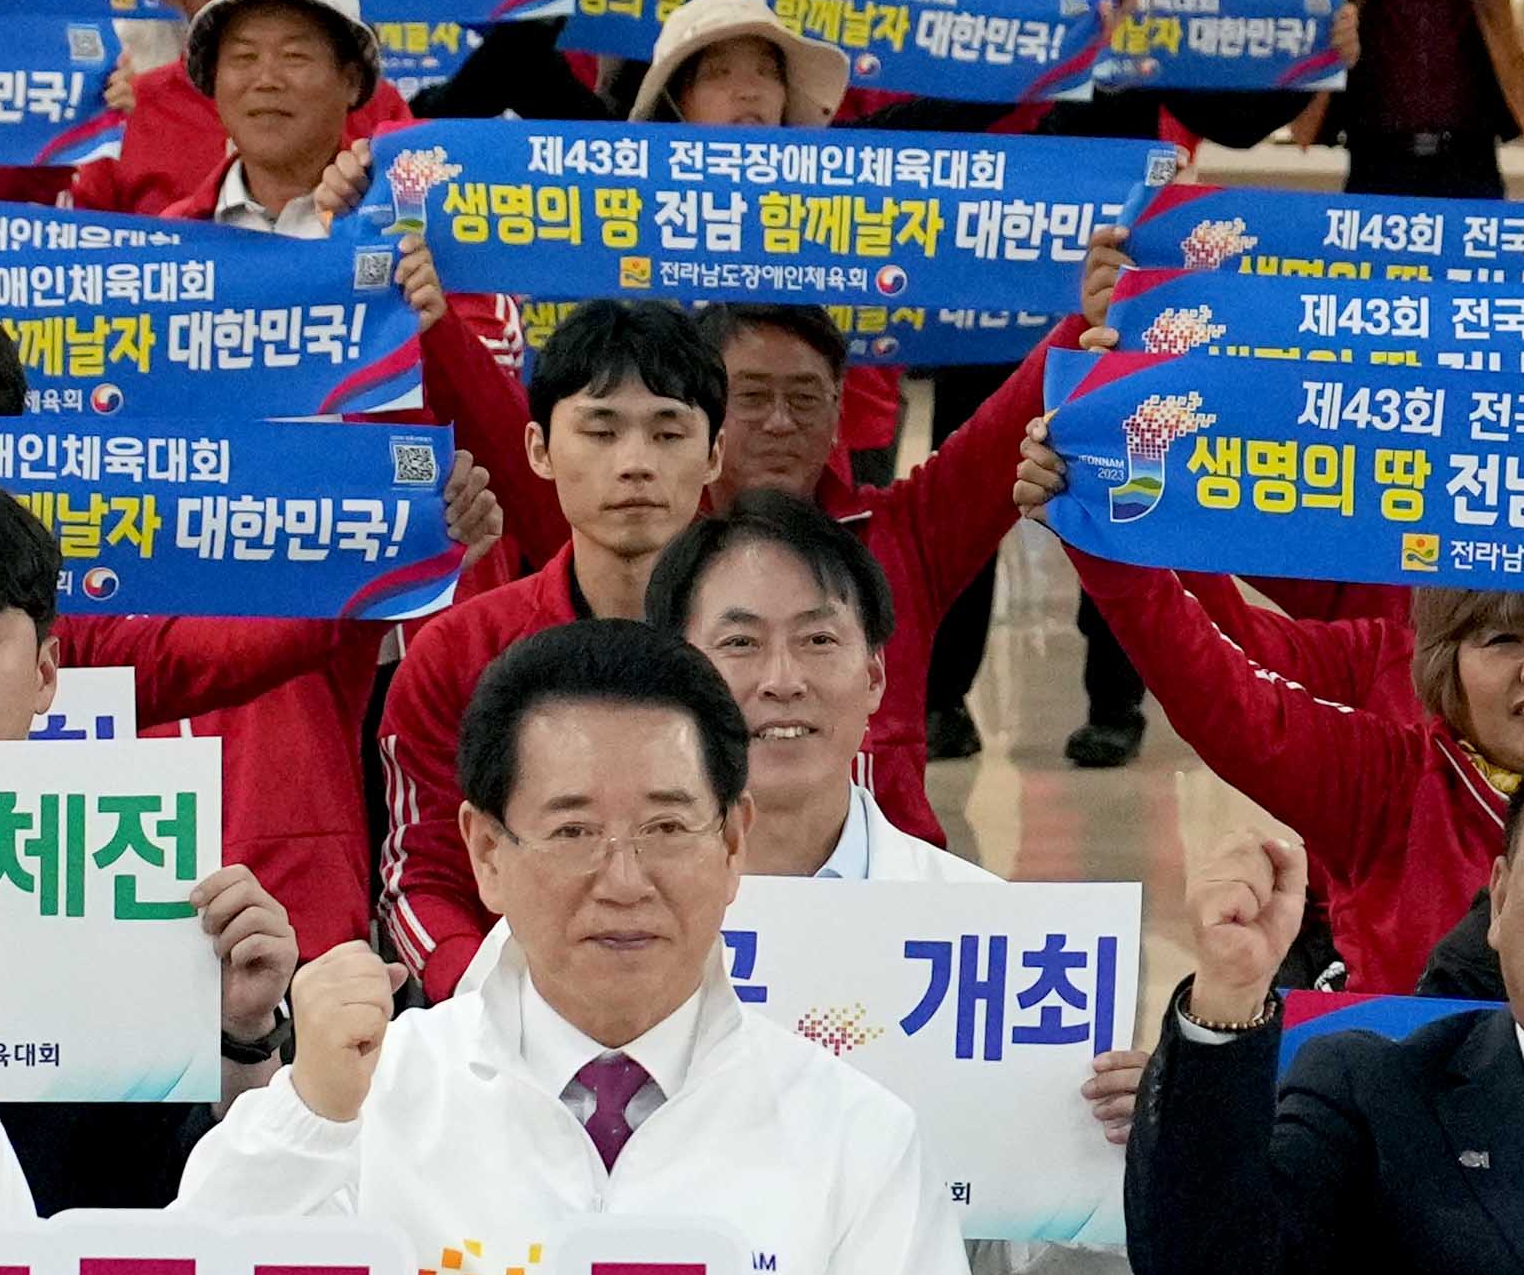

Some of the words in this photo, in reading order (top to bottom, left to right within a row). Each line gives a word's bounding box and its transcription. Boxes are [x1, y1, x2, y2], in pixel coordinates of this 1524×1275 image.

[528, 136, 648, 178] 제43회
[669, 141, 1005, 190] 전국장애인체육대회
[443, 183, 581, 245] 생명의
[595, 189, 642, 248] 땅
[655, 191, 747, 251] 전남
[759, 191, 944, 257] 함께날자
[954, 199, 1128, 262] 대한민
[660, 261, 867, 291] 전라남도장애인체육회
[1298, 382, 1445, 436] 제43회
[1097, 468, 1125, 481] 2023
[1187, 437, 1355, 516] 생명의
[1375, 449, 1431, 521] 땅
[176, 495, 409, 561] 대한민국!
[899, 934, 1118, 1061] 개최
